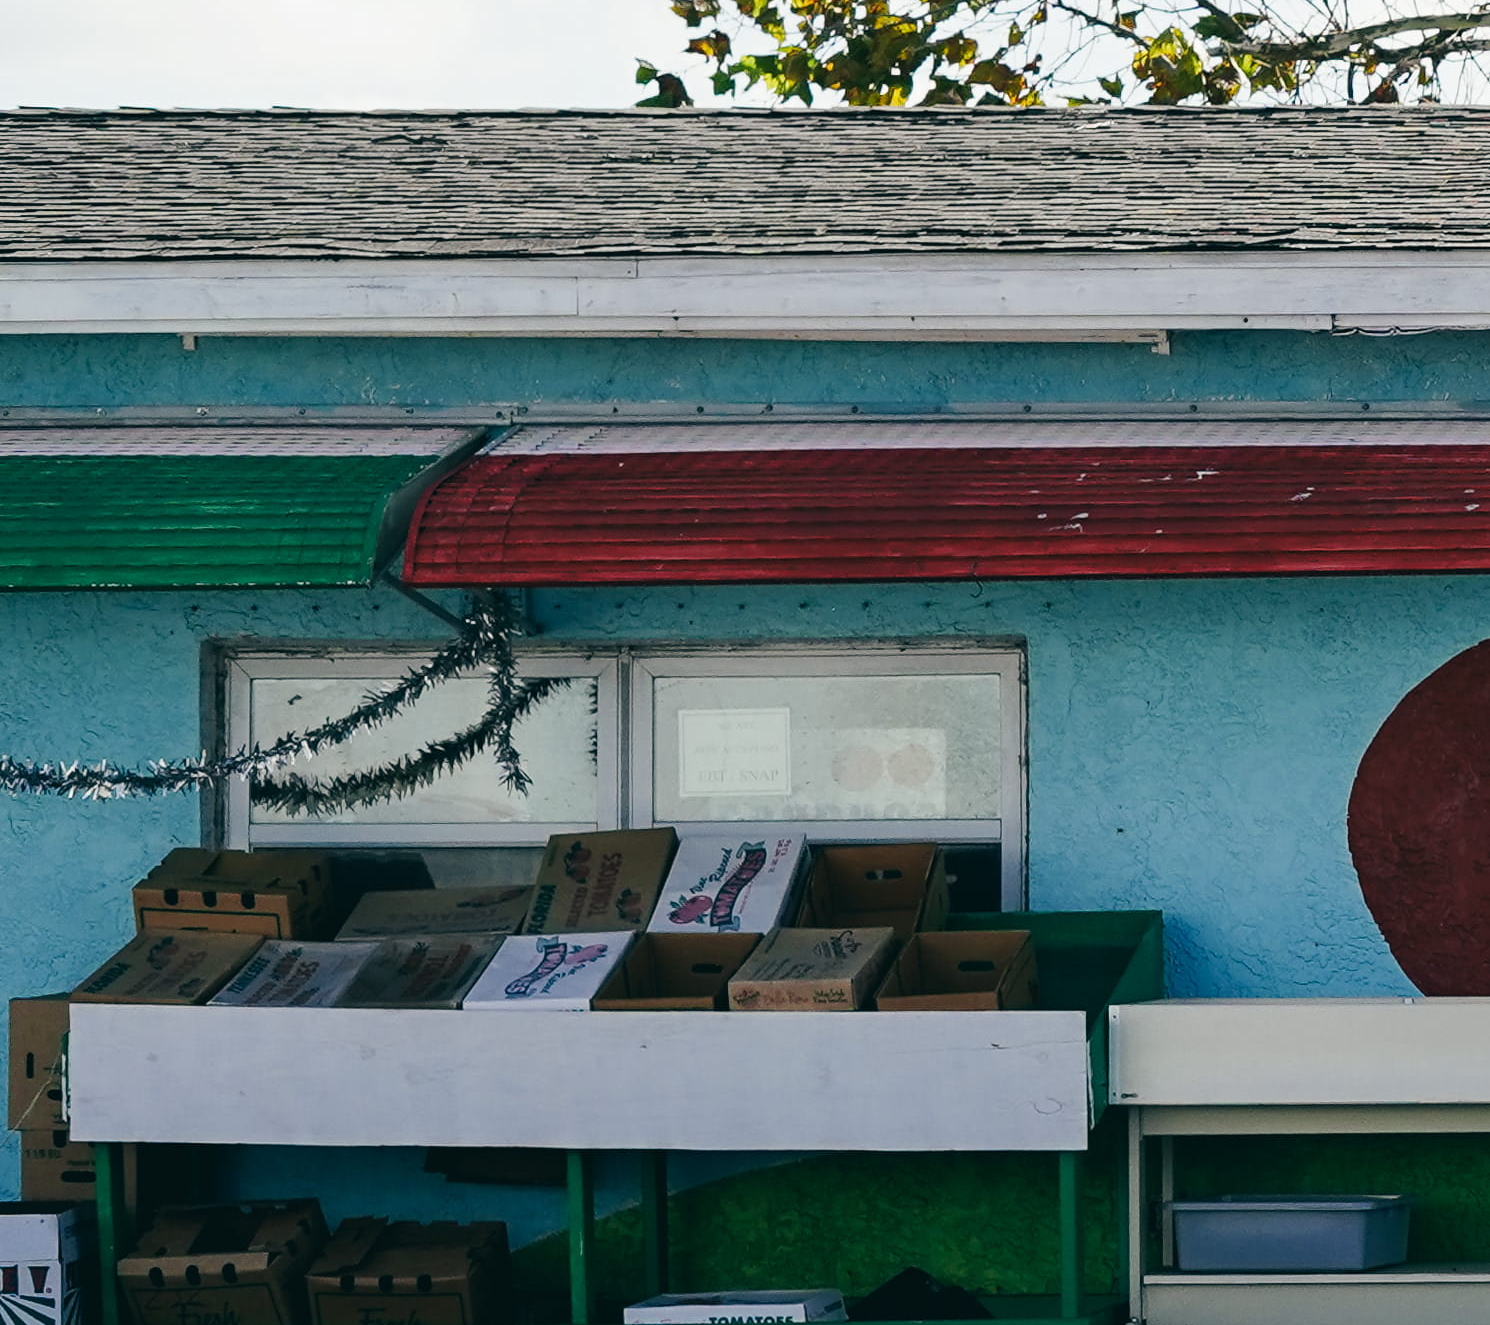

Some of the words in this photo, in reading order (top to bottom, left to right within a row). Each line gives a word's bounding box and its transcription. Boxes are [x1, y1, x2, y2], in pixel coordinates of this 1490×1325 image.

[739, 769, 779, 782] SNAP
[588, 852, 623, 918] TOMATOES
[712, 850, 765, 924] TOMATOES
